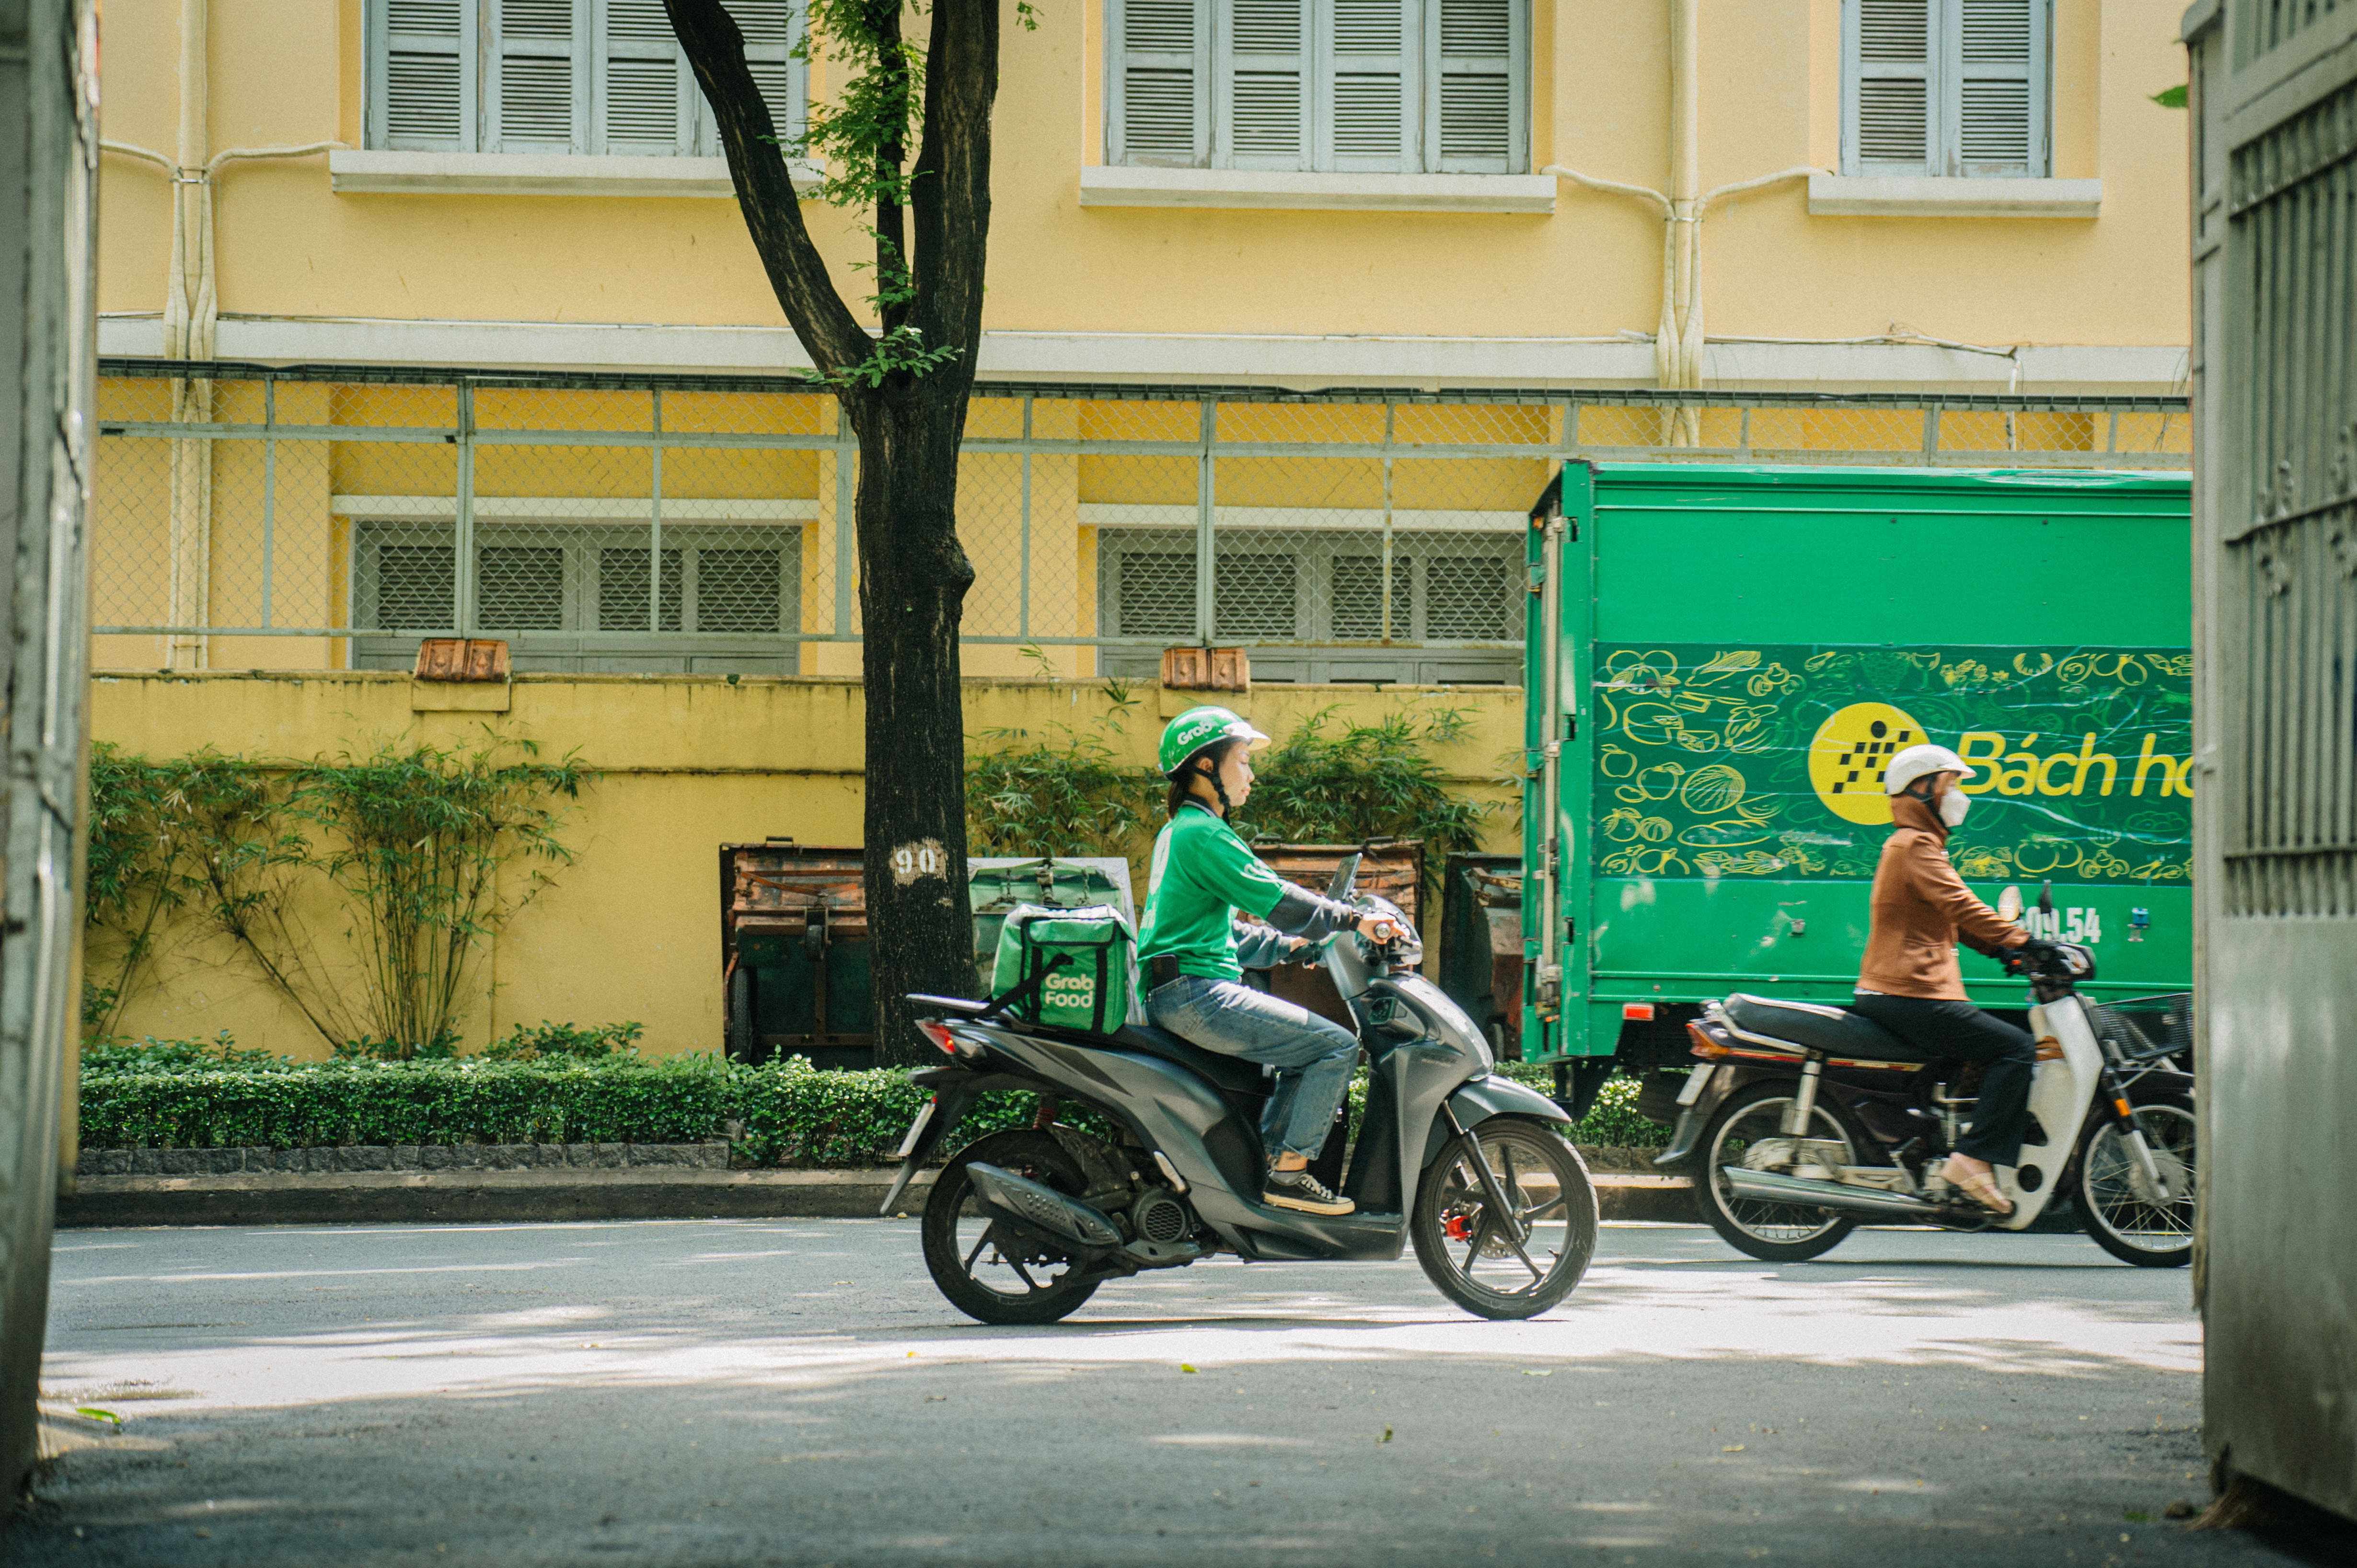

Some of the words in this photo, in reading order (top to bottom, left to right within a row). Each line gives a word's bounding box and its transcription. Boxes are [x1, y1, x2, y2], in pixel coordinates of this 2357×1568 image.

[1177, 720, 1213, 745] Grab
[1956, 731, 2118, 796] Bách
[896, 849, 935, 875] 90
[1045, 973, 1094, 991] Grab
[1045, 991, 1093, 1008] Food
